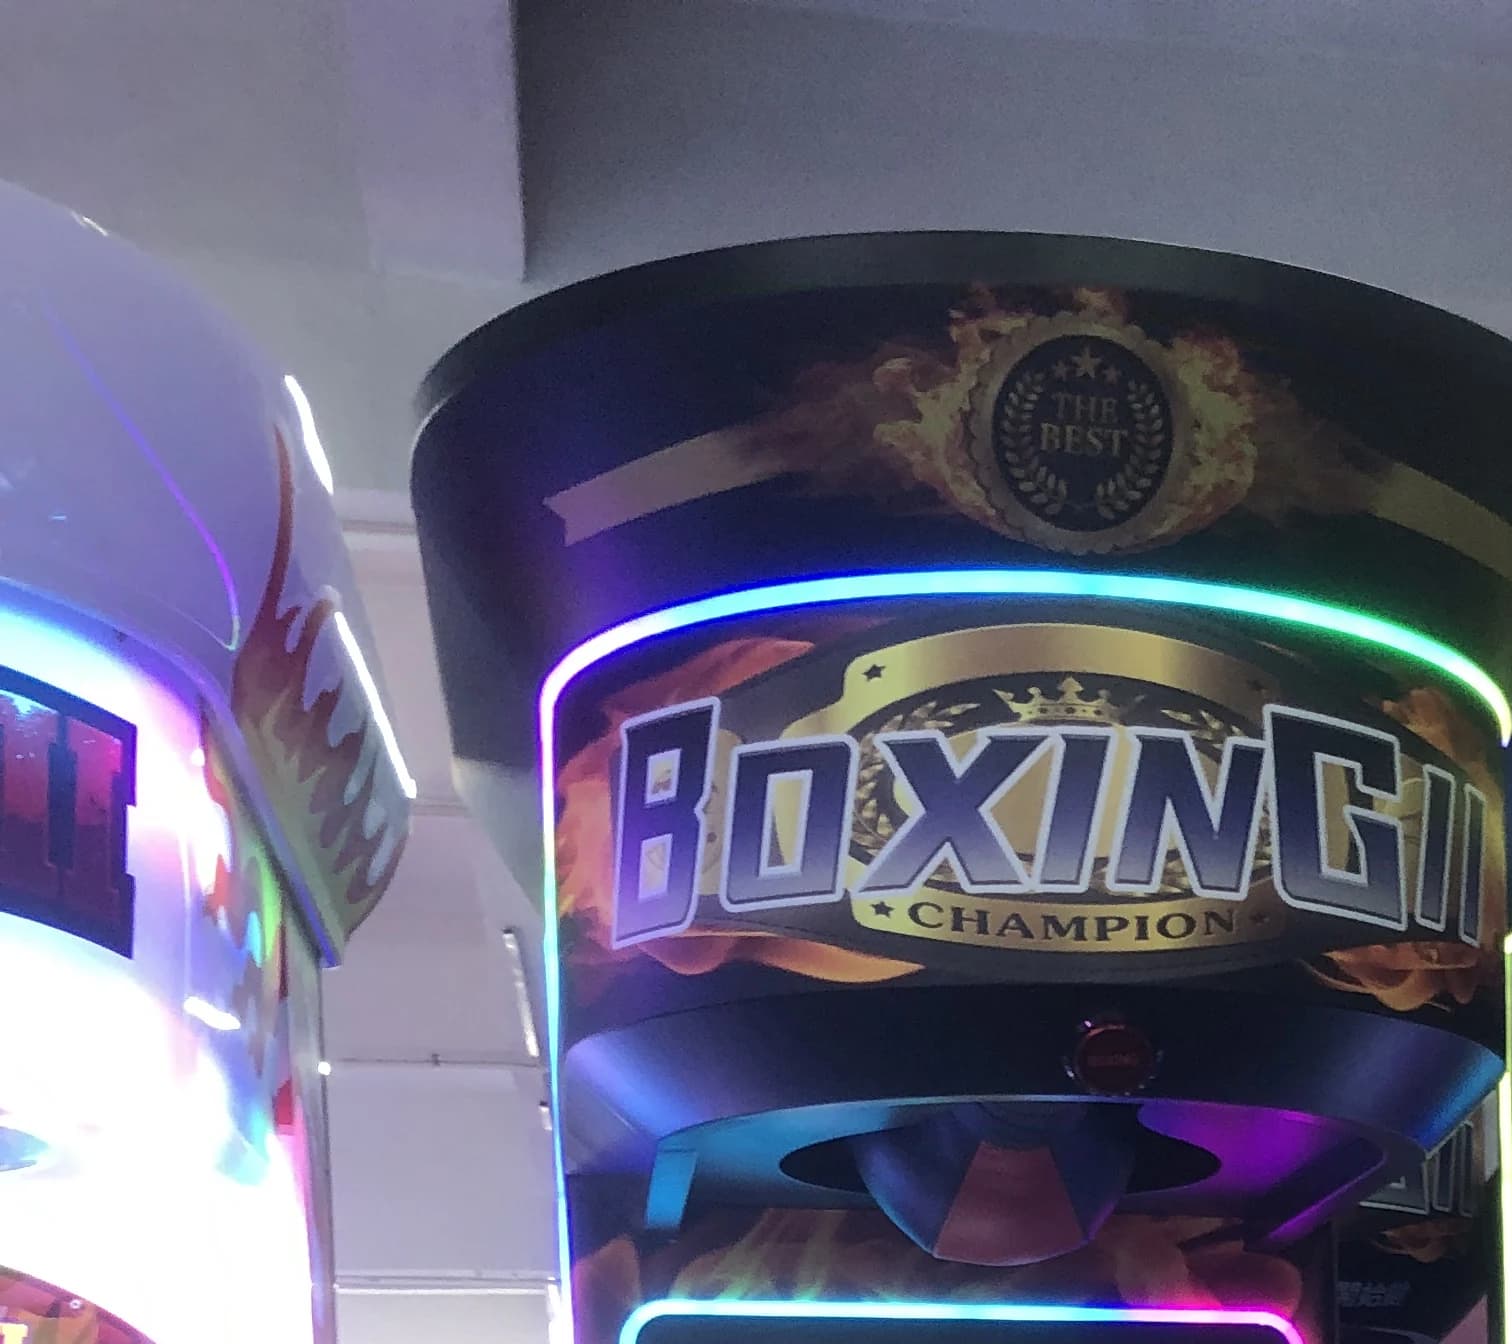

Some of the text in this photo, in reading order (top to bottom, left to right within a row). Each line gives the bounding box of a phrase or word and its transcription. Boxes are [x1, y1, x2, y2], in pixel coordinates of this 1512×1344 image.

[1052, 392, 1118, 423] THE
[1040, 423, 1129, 457] BEST
[908, 901, 1237, 944] CHAMPION
